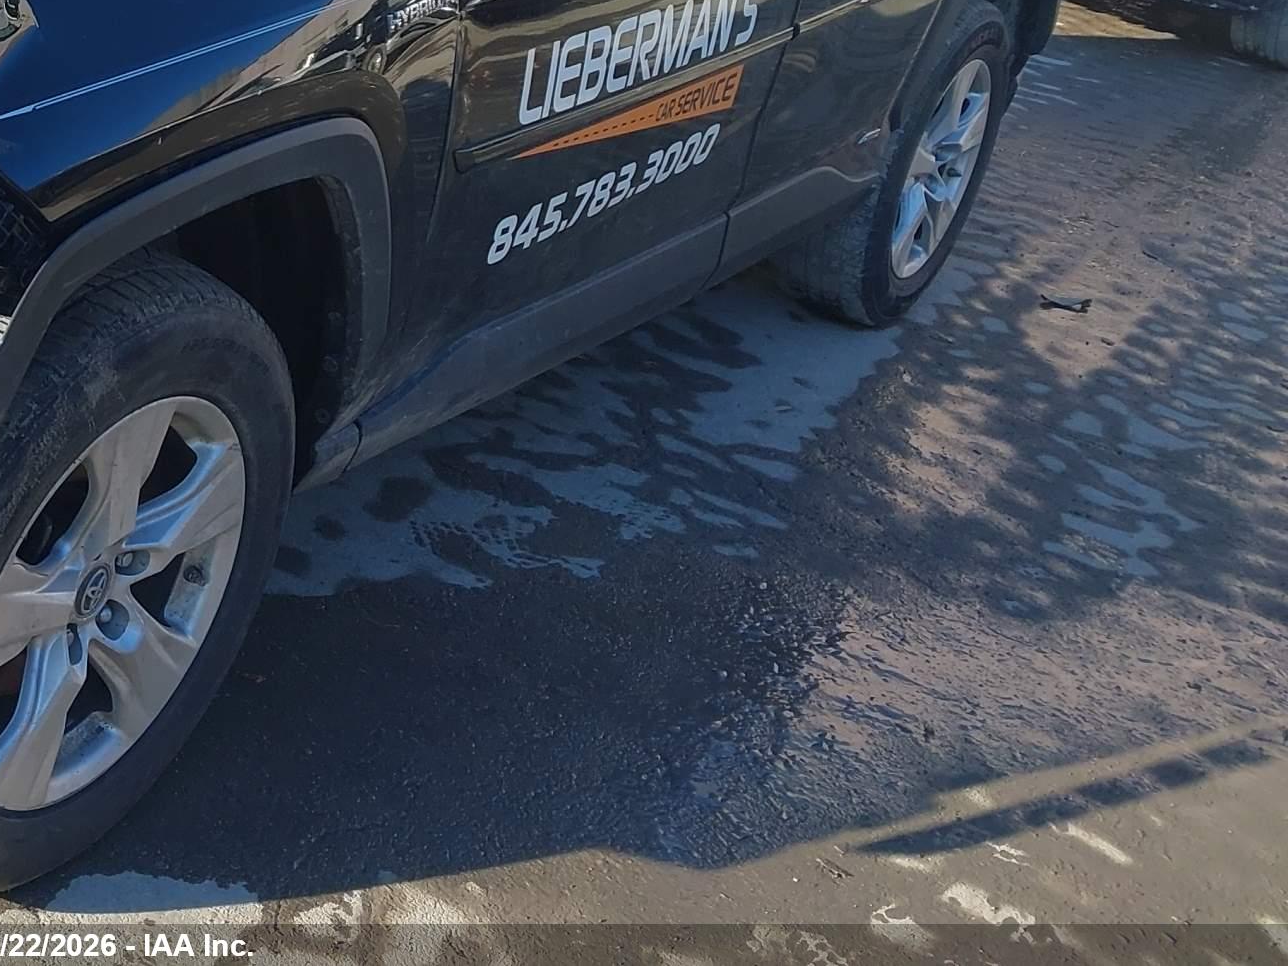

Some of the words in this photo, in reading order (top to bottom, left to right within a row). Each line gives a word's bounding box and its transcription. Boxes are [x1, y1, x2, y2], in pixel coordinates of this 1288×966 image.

[656, 98, 676, 122] CAR
[675, 72, 738, 116] SERVICE
[487, 123, 721, 265] 845.783.3000
